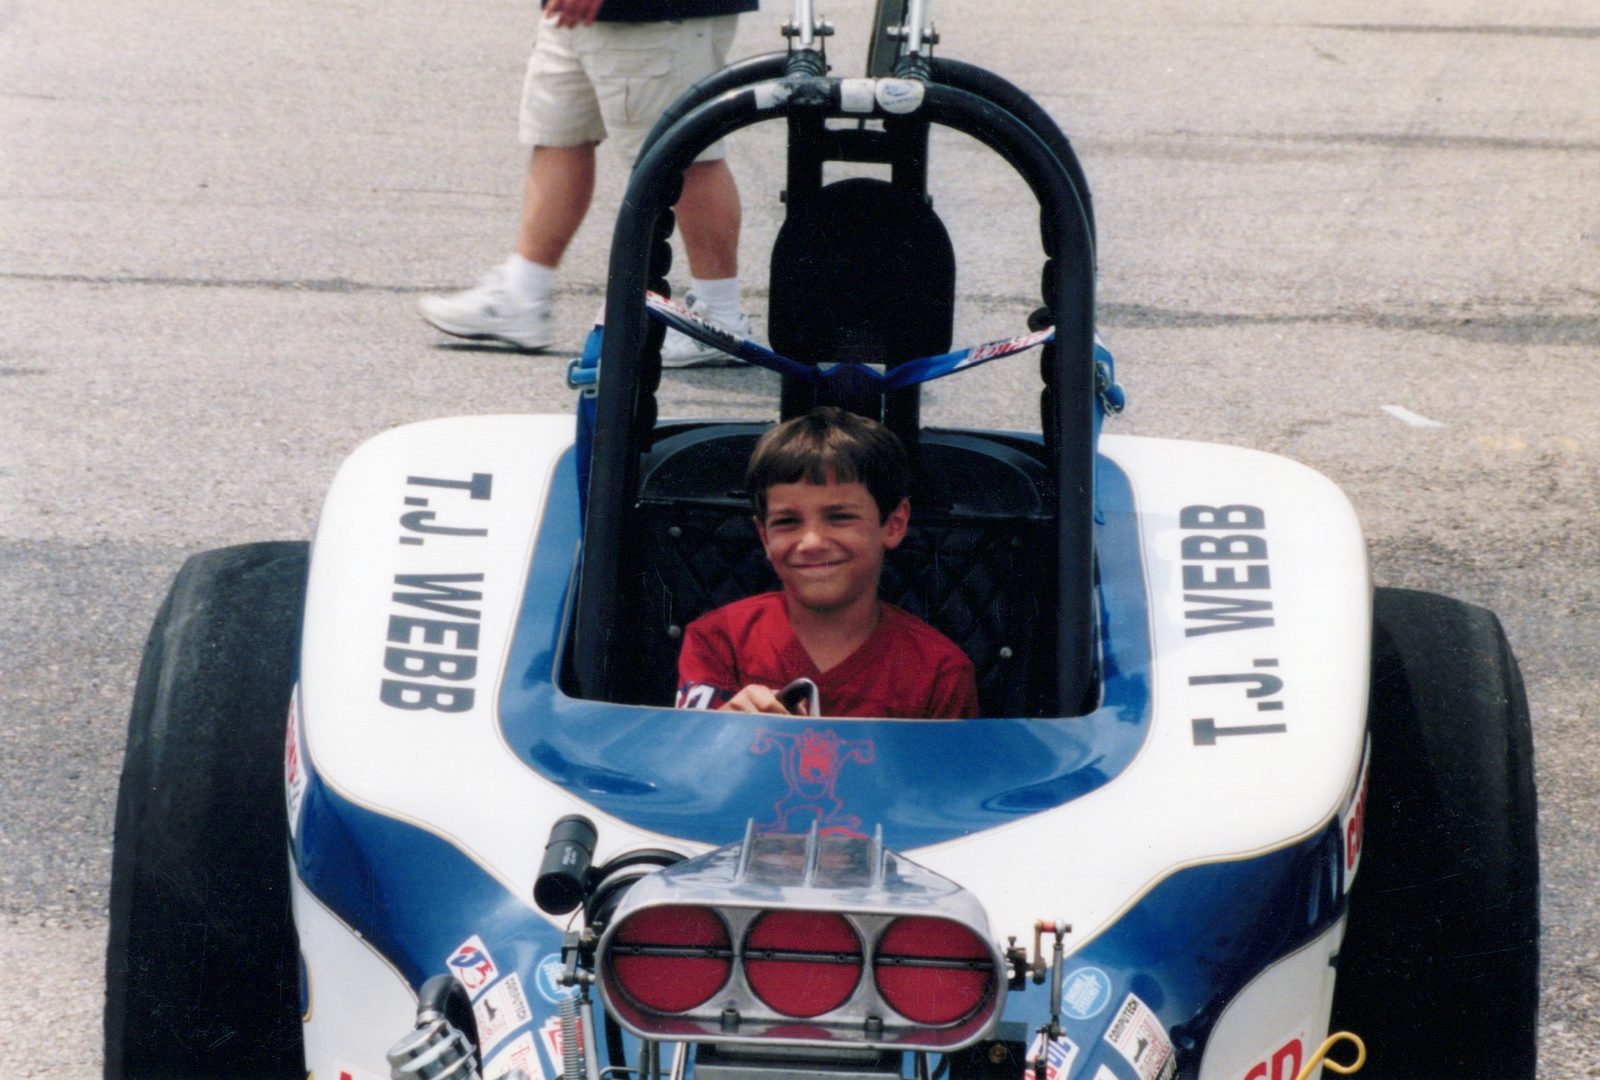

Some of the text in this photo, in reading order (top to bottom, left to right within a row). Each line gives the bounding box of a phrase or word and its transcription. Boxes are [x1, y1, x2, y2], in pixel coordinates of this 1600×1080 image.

[379, 472, 493, 713] T.J. WEBB
[1179, 503, 1288, 747] T.J. WEBB
[1107, 997, 1138, 1042] COMPUTECH
